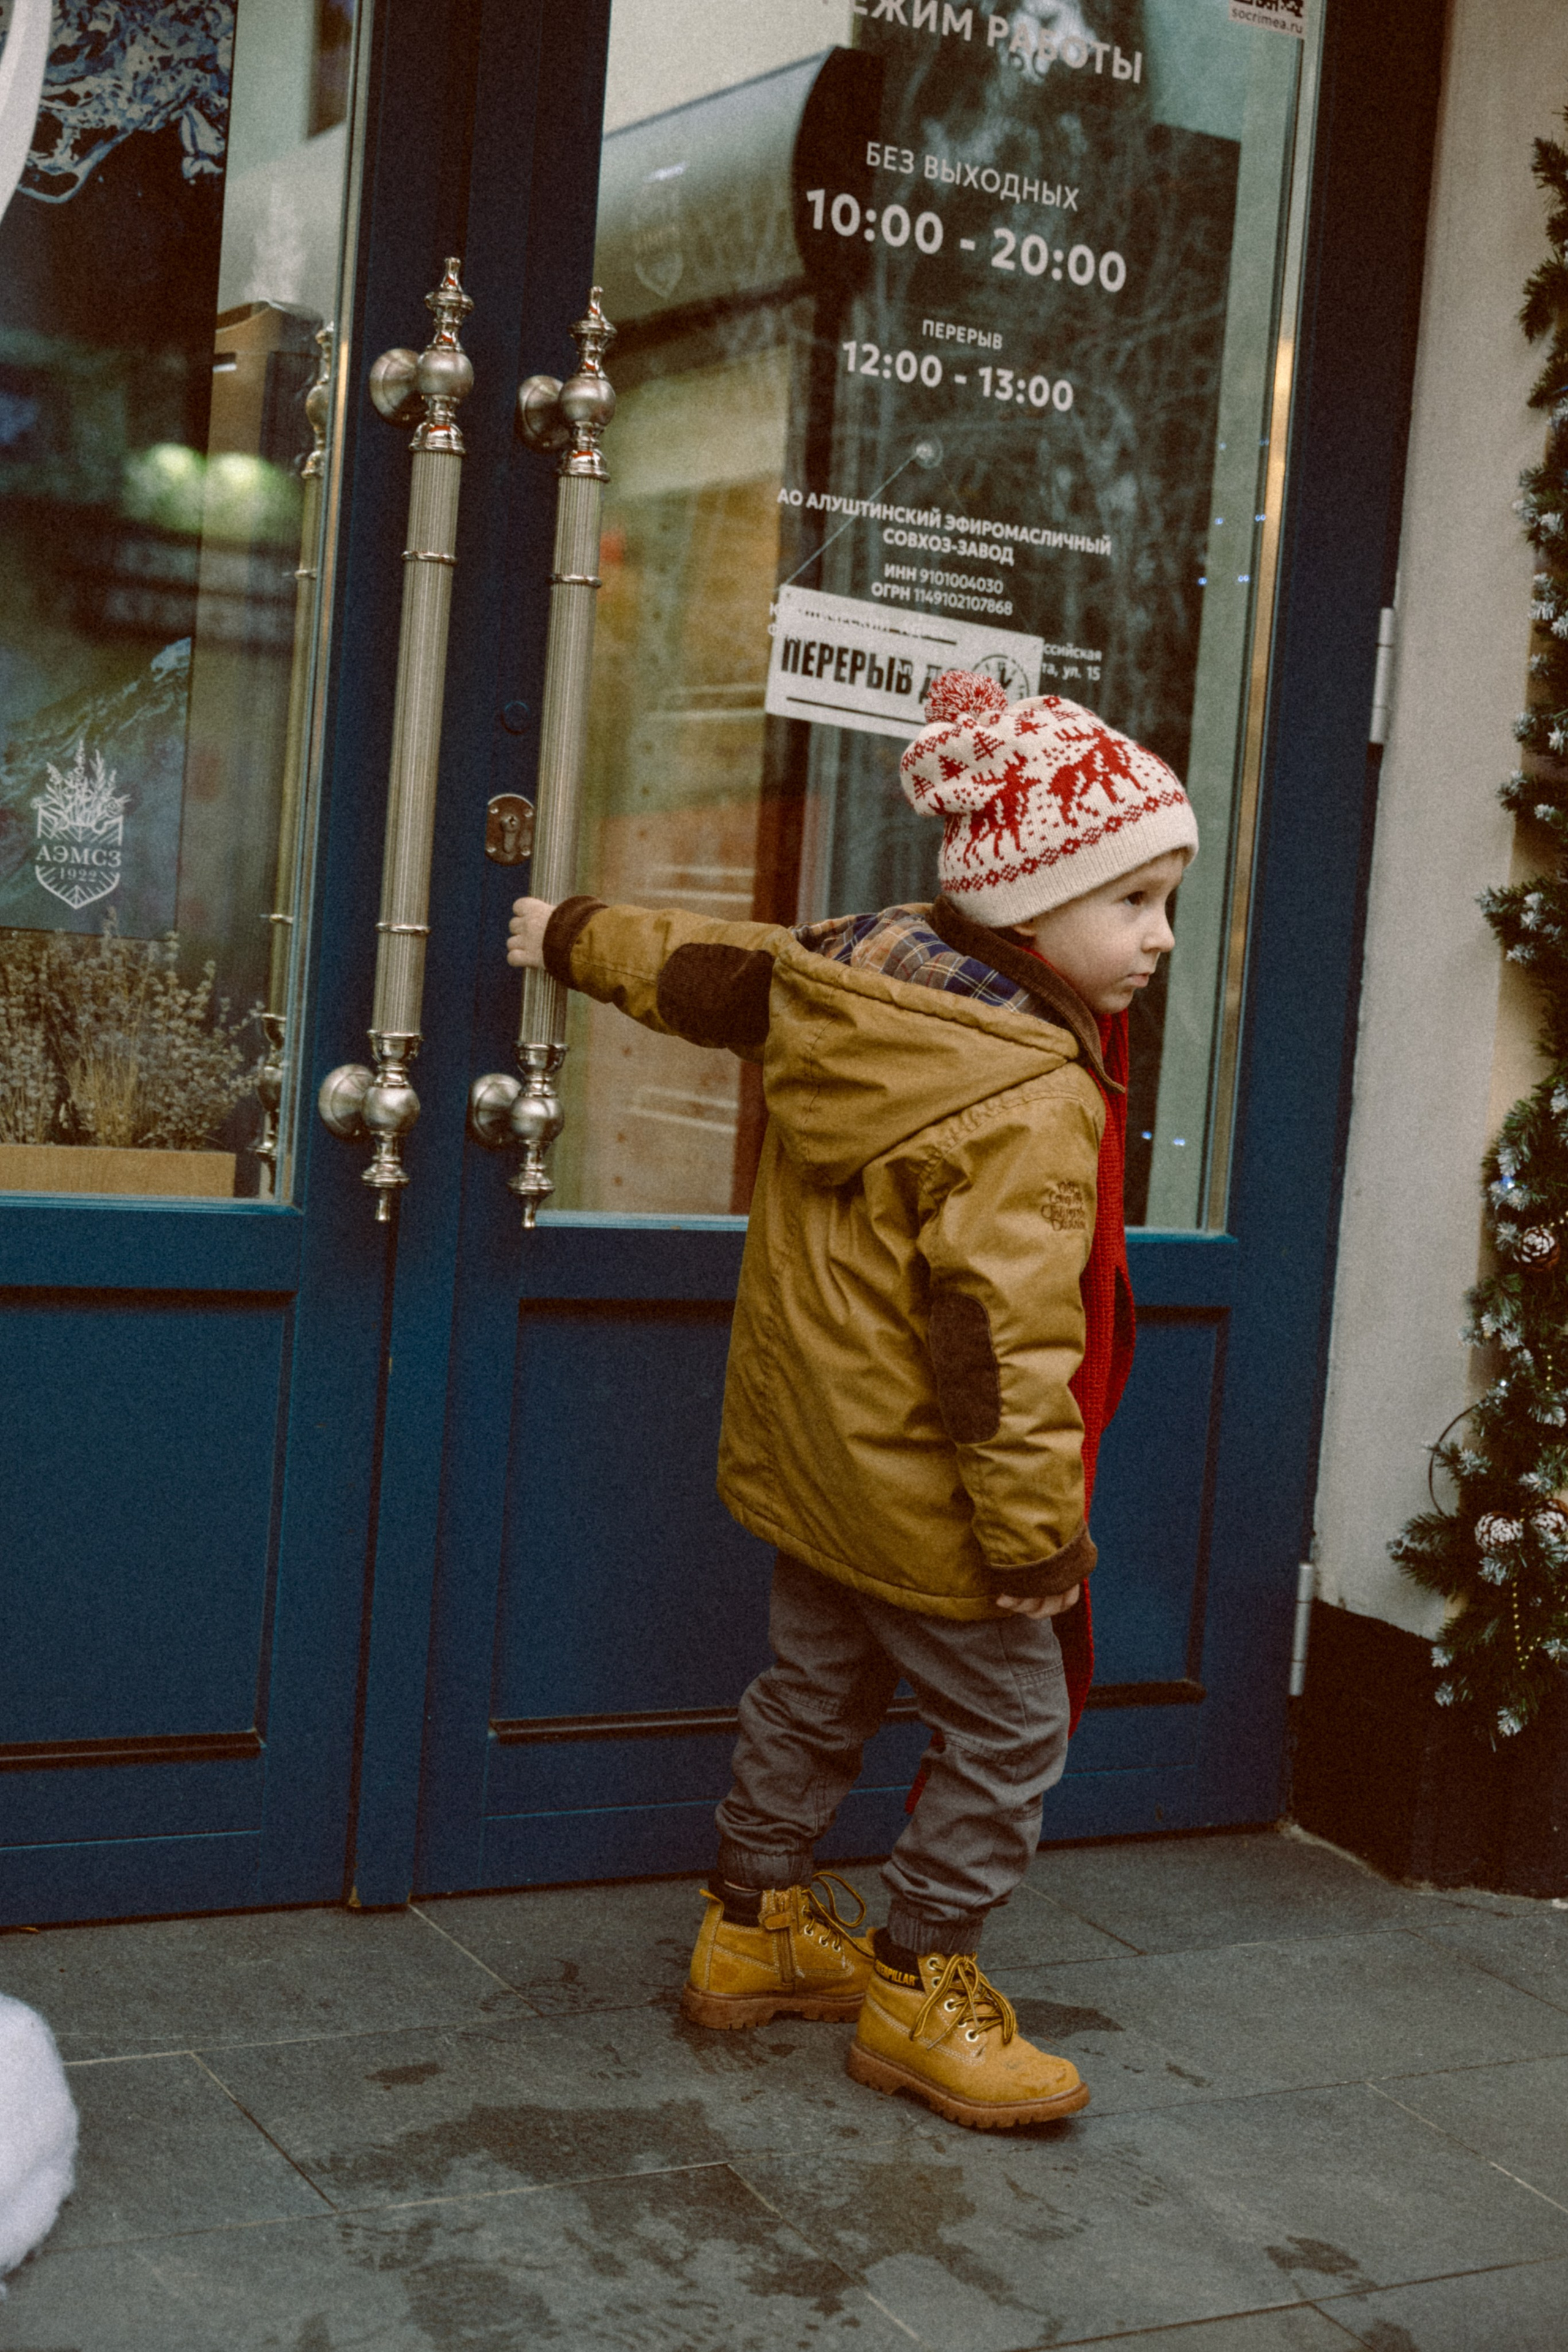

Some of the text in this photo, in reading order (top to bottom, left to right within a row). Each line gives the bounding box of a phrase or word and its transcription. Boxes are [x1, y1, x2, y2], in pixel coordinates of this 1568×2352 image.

[1231, 7, 1303, 34] socrimea.ru
[987, 14, 1142, 83] РАБОТЫ
[866, 141, 1079, 211] БЕЗ ВЫХОДНЫХ
[806, 189, 943, 254] 10:00
[991, 228, 1126, 293] 20:00
[922, 319, 1003, 350] ПЕРЕРЫВ
[842, 341, 943, 387] 12:00
[979, 366, 1073, 412] 13:00
[777, 488, 1112, 556] АО АЛУШТИНСКИЙ ЭФИРОМАСЛИЧНЫЙ
[883, 528, 1015, 567] СОВХОЗ-ЗАВОД
[884, 563, 1004, 595] ИНН 9101004030
[871, 582, 1014, 616] ОГРН 1149102107868
[781, 636, 913, 695] ПЕРЕРЫВ
[1043, 642, 1102, 662] ссийская
[1086, 665, 1101, 681] 15
[36, 845, 121, 867] АЭМСЗ
[61, 867, 97, 882] 1922
